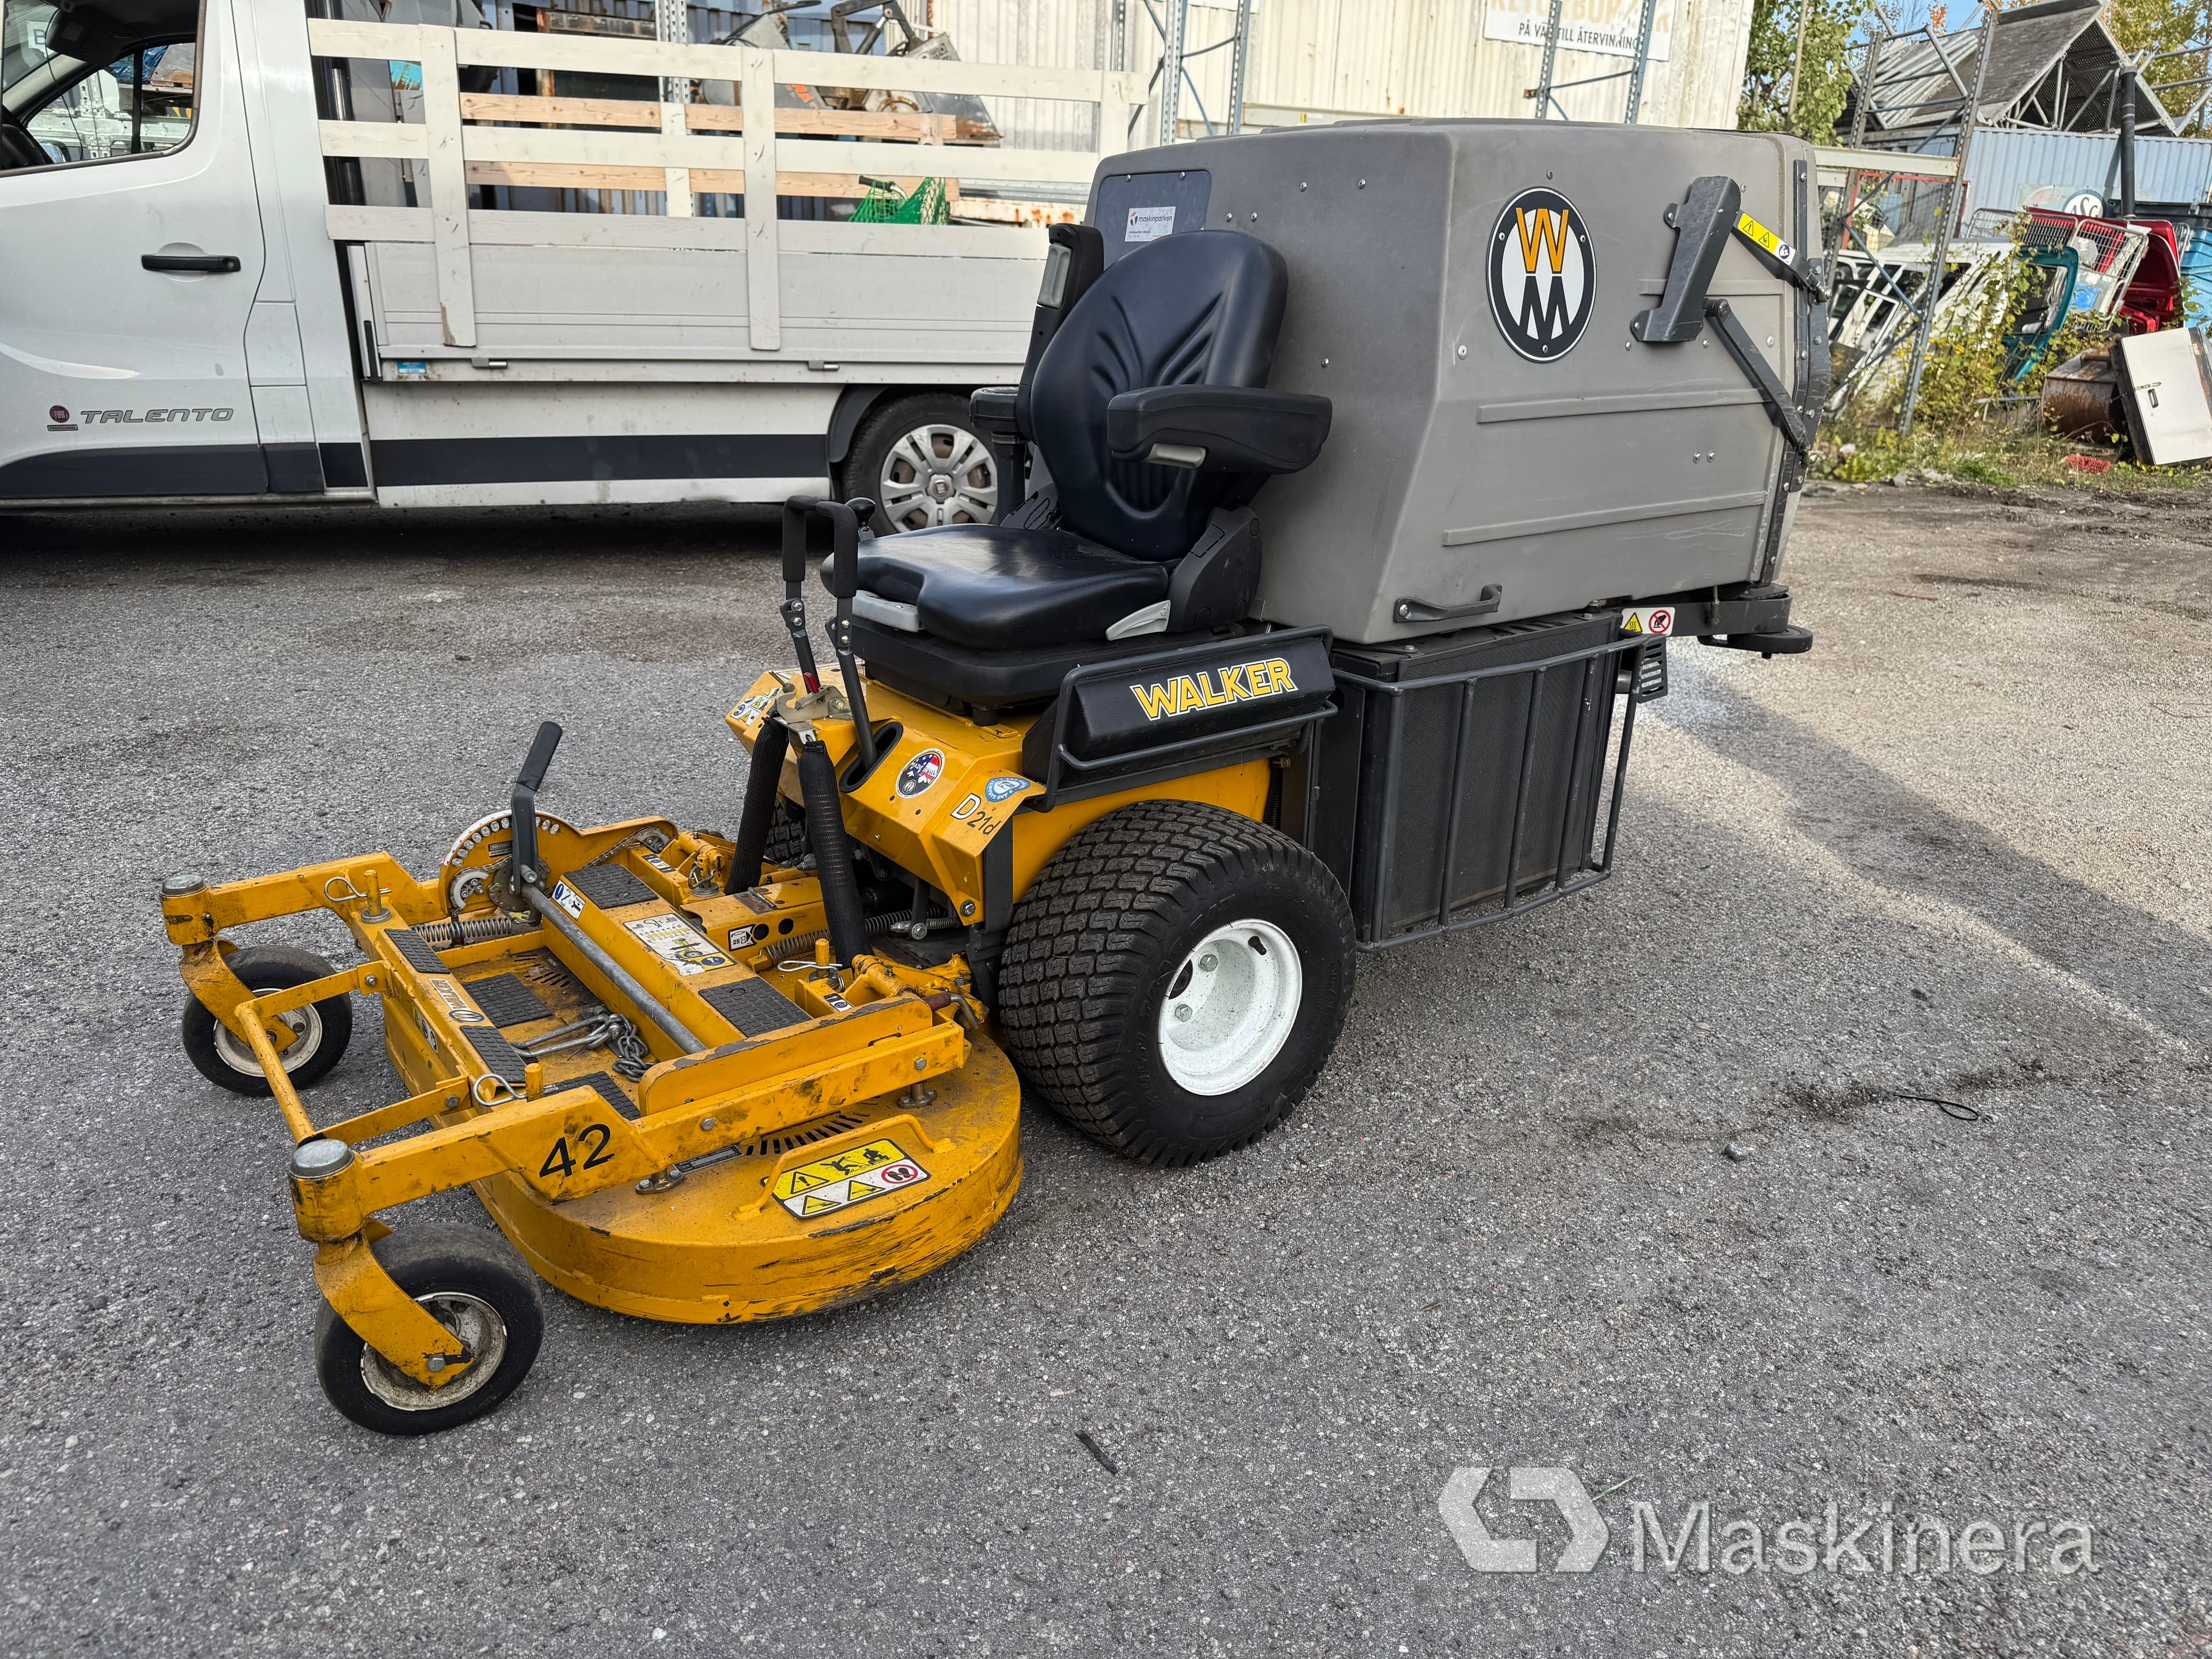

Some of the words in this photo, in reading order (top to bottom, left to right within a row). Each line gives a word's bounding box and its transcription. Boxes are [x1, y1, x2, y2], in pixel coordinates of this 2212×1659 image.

[1518, 19, 1530, 36] PÅ
[1138, 214, 1173, 223] maskinparken
[54, 411, 66, 419] FIAT
[81, 408, 234, 424] TALENTO
[1129, 657, 1298, 721] WALKER
[911, 761, 924, 771] MADE
[431, 980, 467, 1009] WALKER
[539, 1123, 615, 1179] 42
